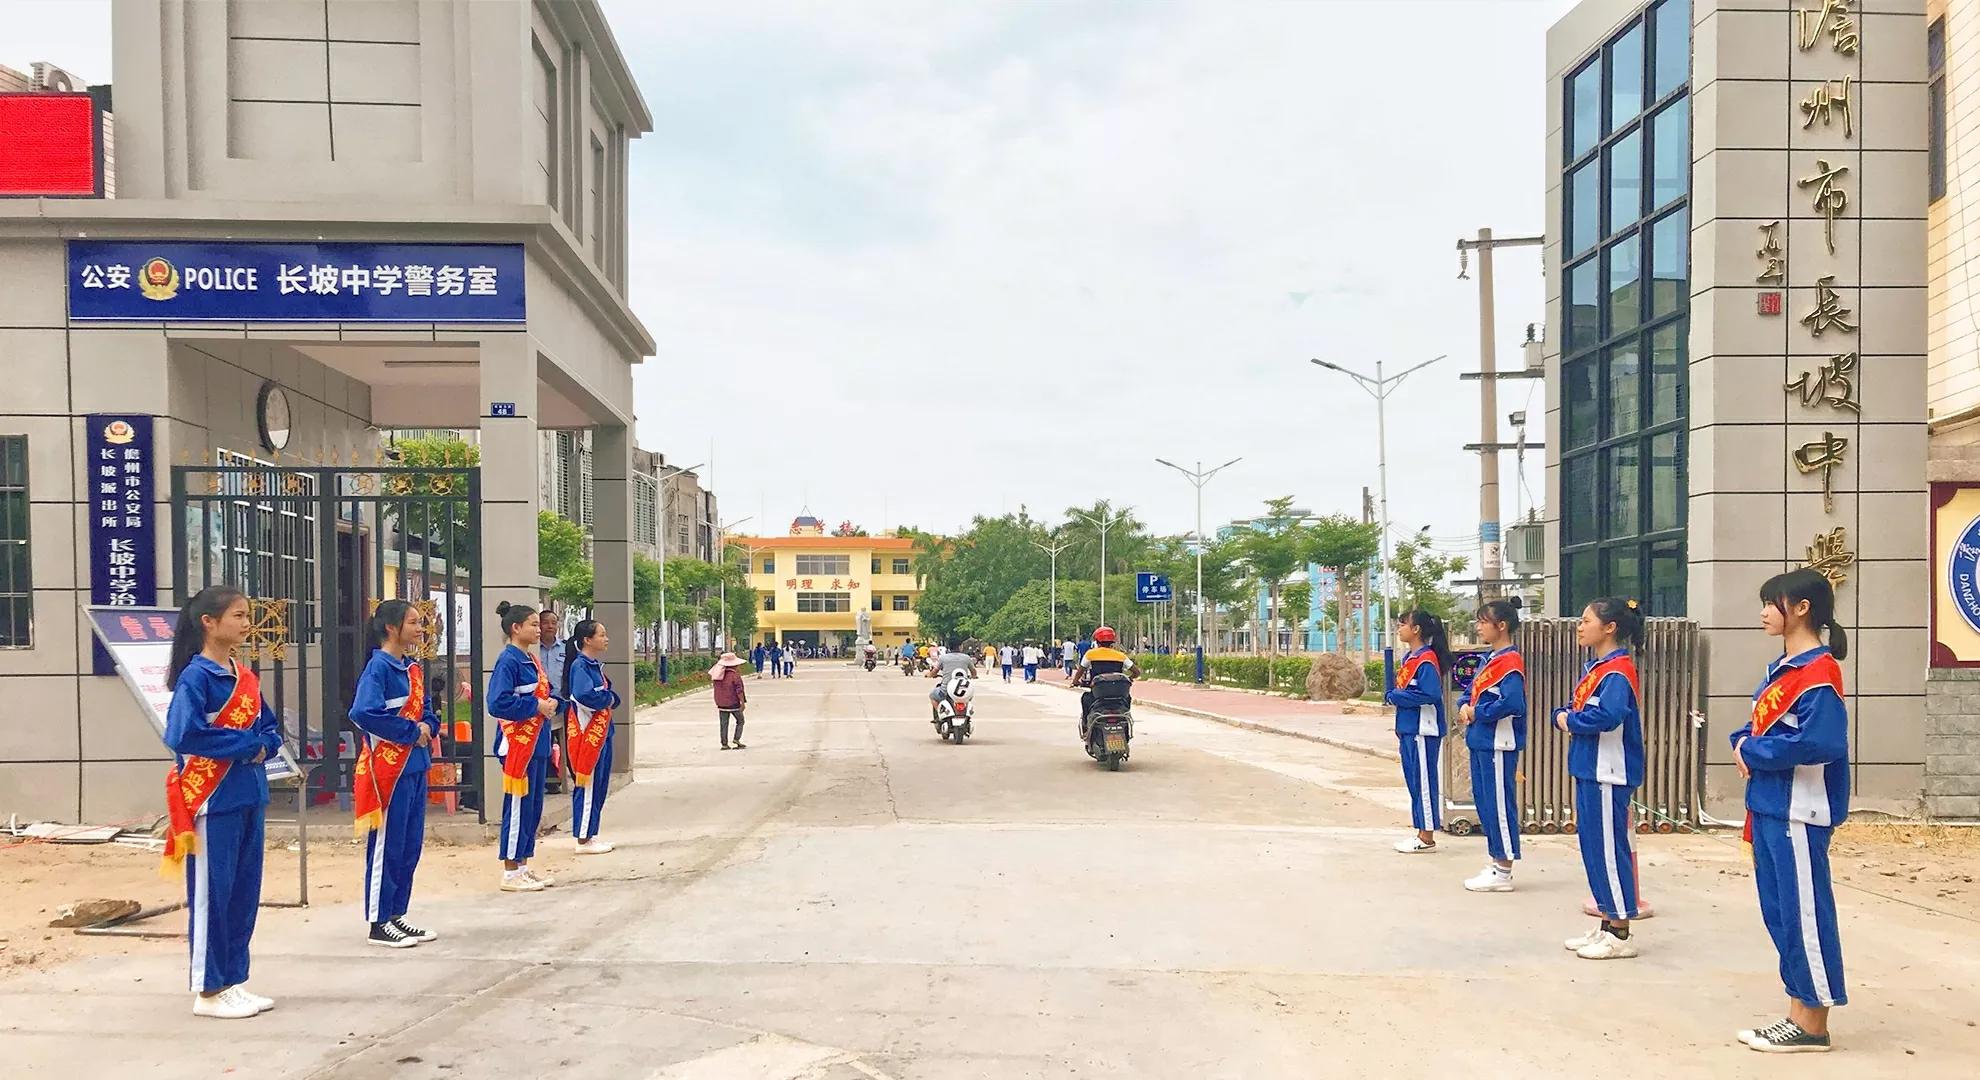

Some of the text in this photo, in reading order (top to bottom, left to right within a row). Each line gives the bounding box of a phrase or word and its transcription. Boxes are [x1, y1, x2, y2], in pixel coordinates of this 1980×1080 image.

[81, 263, 499, 297] 公安 POLICE 长坡中学警务室
[100, 448, 118, 528] 长坡派出所
[124, 448, 141, 528] 儋州市公安局
[108, 538, 137, 606] 长坡中学治
[786, 578, 860, 590] 明理 求知
[1150, 574, 1159, 586] P
[1959, 573, 1980, 622] DANZHO
